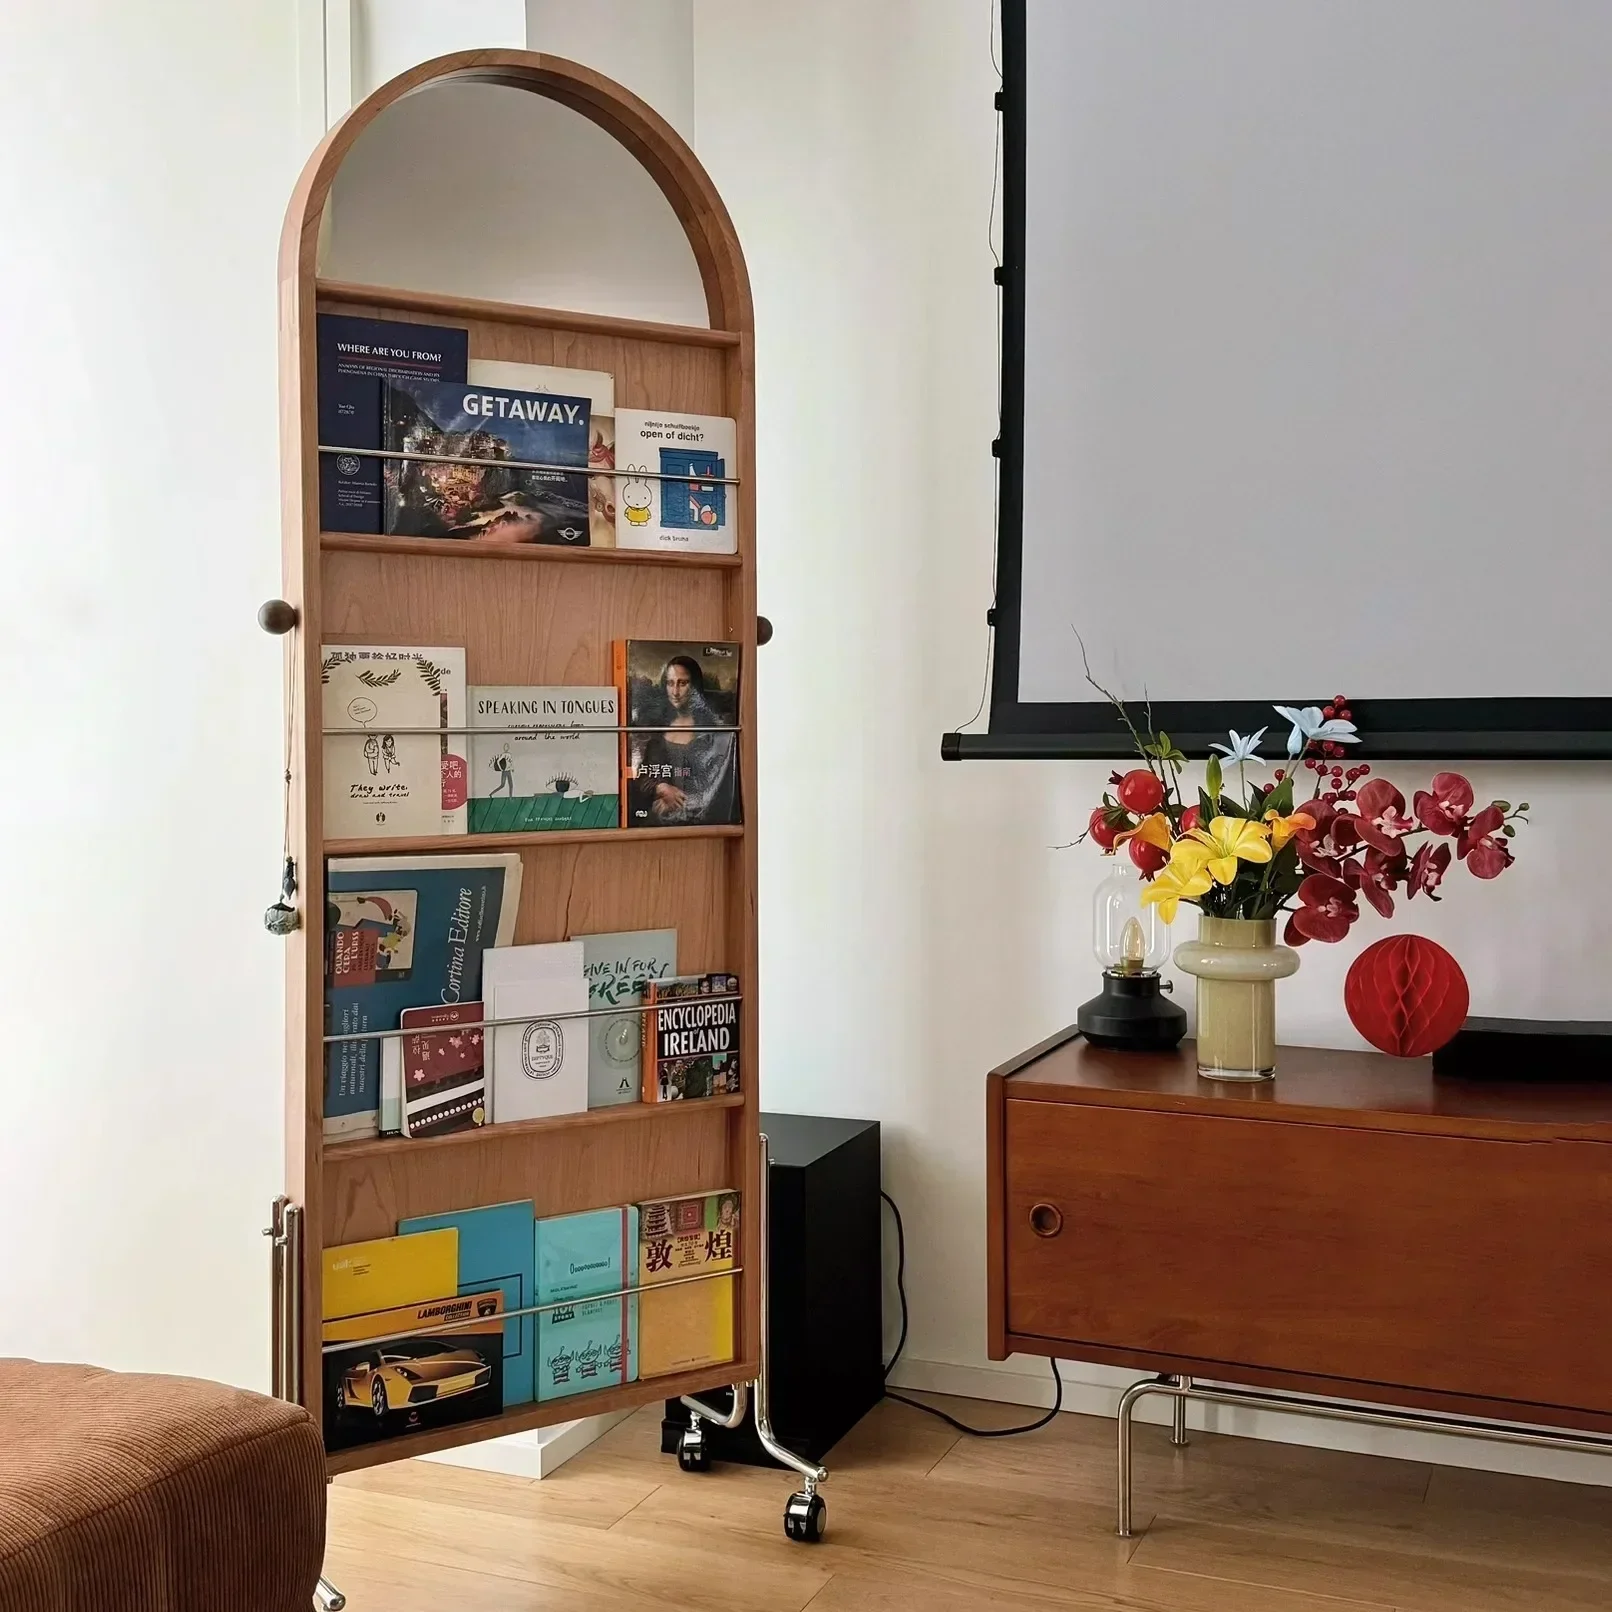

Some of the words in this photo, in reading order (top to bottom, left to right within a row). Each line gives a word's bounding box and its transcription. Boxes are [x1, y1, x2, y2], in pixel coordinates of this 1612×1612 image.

[337, 342, 370, 354] WHERE
[372, 346, 389, 356] ARE
[390, 348, 410, 359] YOU
[412, 350, 442, 362] FROM?
[462, 393, 584, 426] GETAWAY.
[640, 430, 663, 440] open
[666, 431, 675, 439] of
[677, 432, 704, 442] dicht?
[478, 700, 538, 714] SPEAKING
[543, 700, 557, 714] IN
[561, 700, 614, 714] TONGUES
[544, 732, 556, 740] the
[637, 764, 673, 779] 卢浮宫
[350, 784, 374, 794] They
[448, 887, 472, 944] Editore
[335, 931, 345, 974] QUANDO
[440, 946, 465, 1004] Cortina
[615, 957, 631, 974] IN
[632, 957, 658, 974] FOR
[658, 1002, 736, 1031] ENCYCLOPEDIA
[664, 1027, 730, 1056] IRELAND
[646, 1239, 673, 1273] 敦
[705, 1229, 732, 1262] 煌
[417, 1301, 472, 1319] LAMBORGHINI
